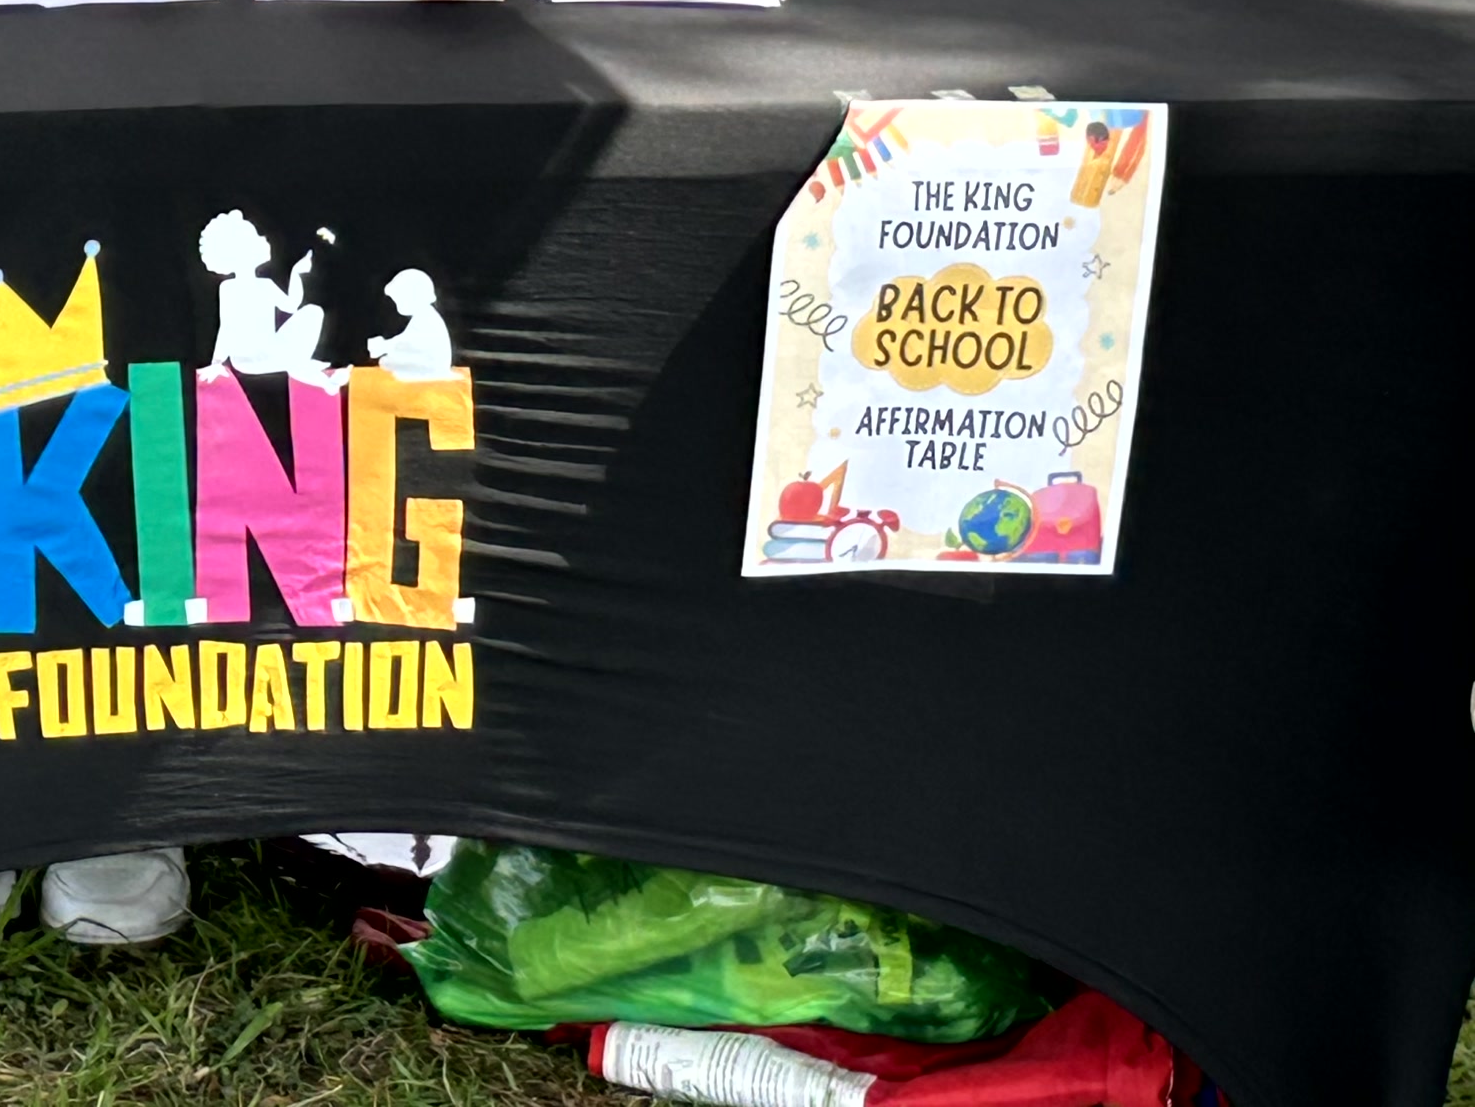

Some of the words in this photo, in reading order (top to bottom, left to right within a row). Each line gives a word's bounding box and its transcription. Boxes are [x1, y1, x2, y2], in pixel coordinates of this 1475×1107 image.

[912, 181, 954, 212] THE
[964, 181, 1035, 211] KING
[879, 220, 1060, 251] FOUNDATION
[876, 282, 985, 325] BACK
[995, 286, 1042, 324] TO
[874, 329, 1033, 372] SCHOOL
[855, 405, 1046, 439] AFFIRMATION
[905, 439, 987, 471] TABLE
